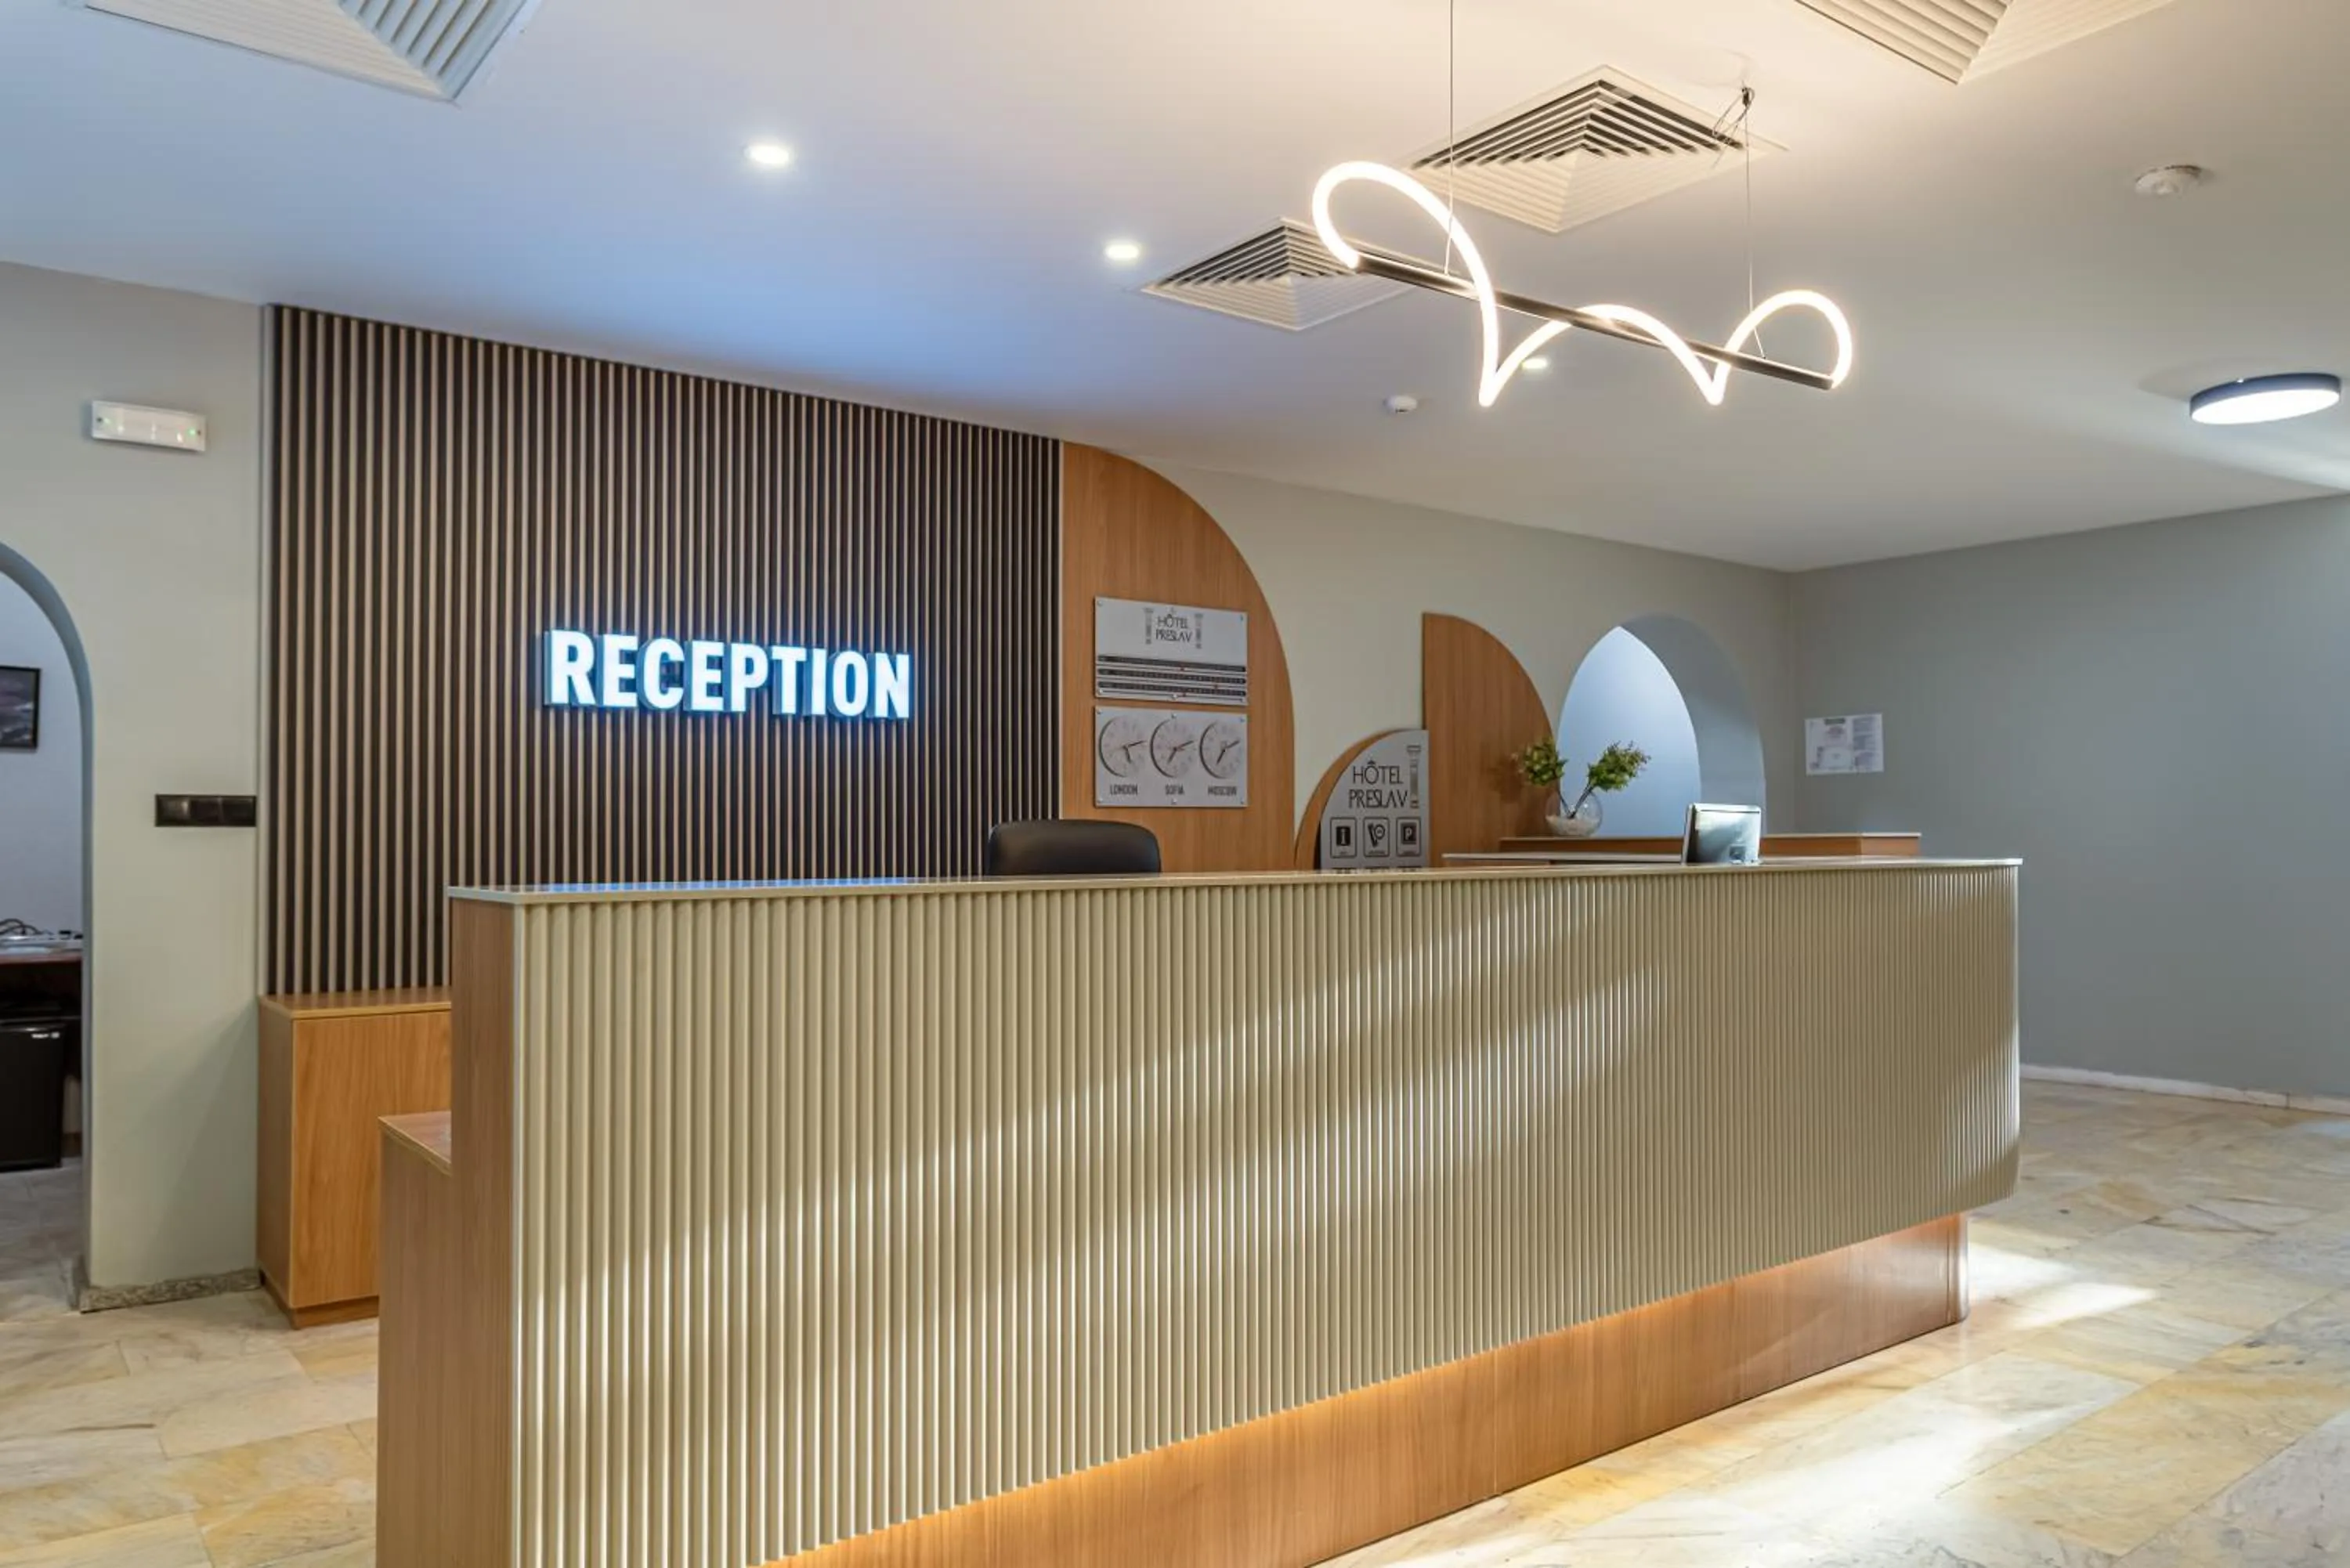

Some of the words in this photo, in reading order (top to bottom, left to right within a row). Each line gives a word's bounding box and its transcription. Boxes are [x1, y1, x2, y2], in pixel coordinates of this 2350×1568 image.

[1155, 629, 1193, 642] PRESLAV
[548, 629, 910, 719] RECEPTION
[1353, 760, 1404, 784] HÔTEL
[1109, 784, 1138, 796] LONDON
[1165, 785, 1184, 796] SOFIA
[1207, 786, 1237, 797] MOSCOW
[1348, 789, 1408, 809] PRESLAV
